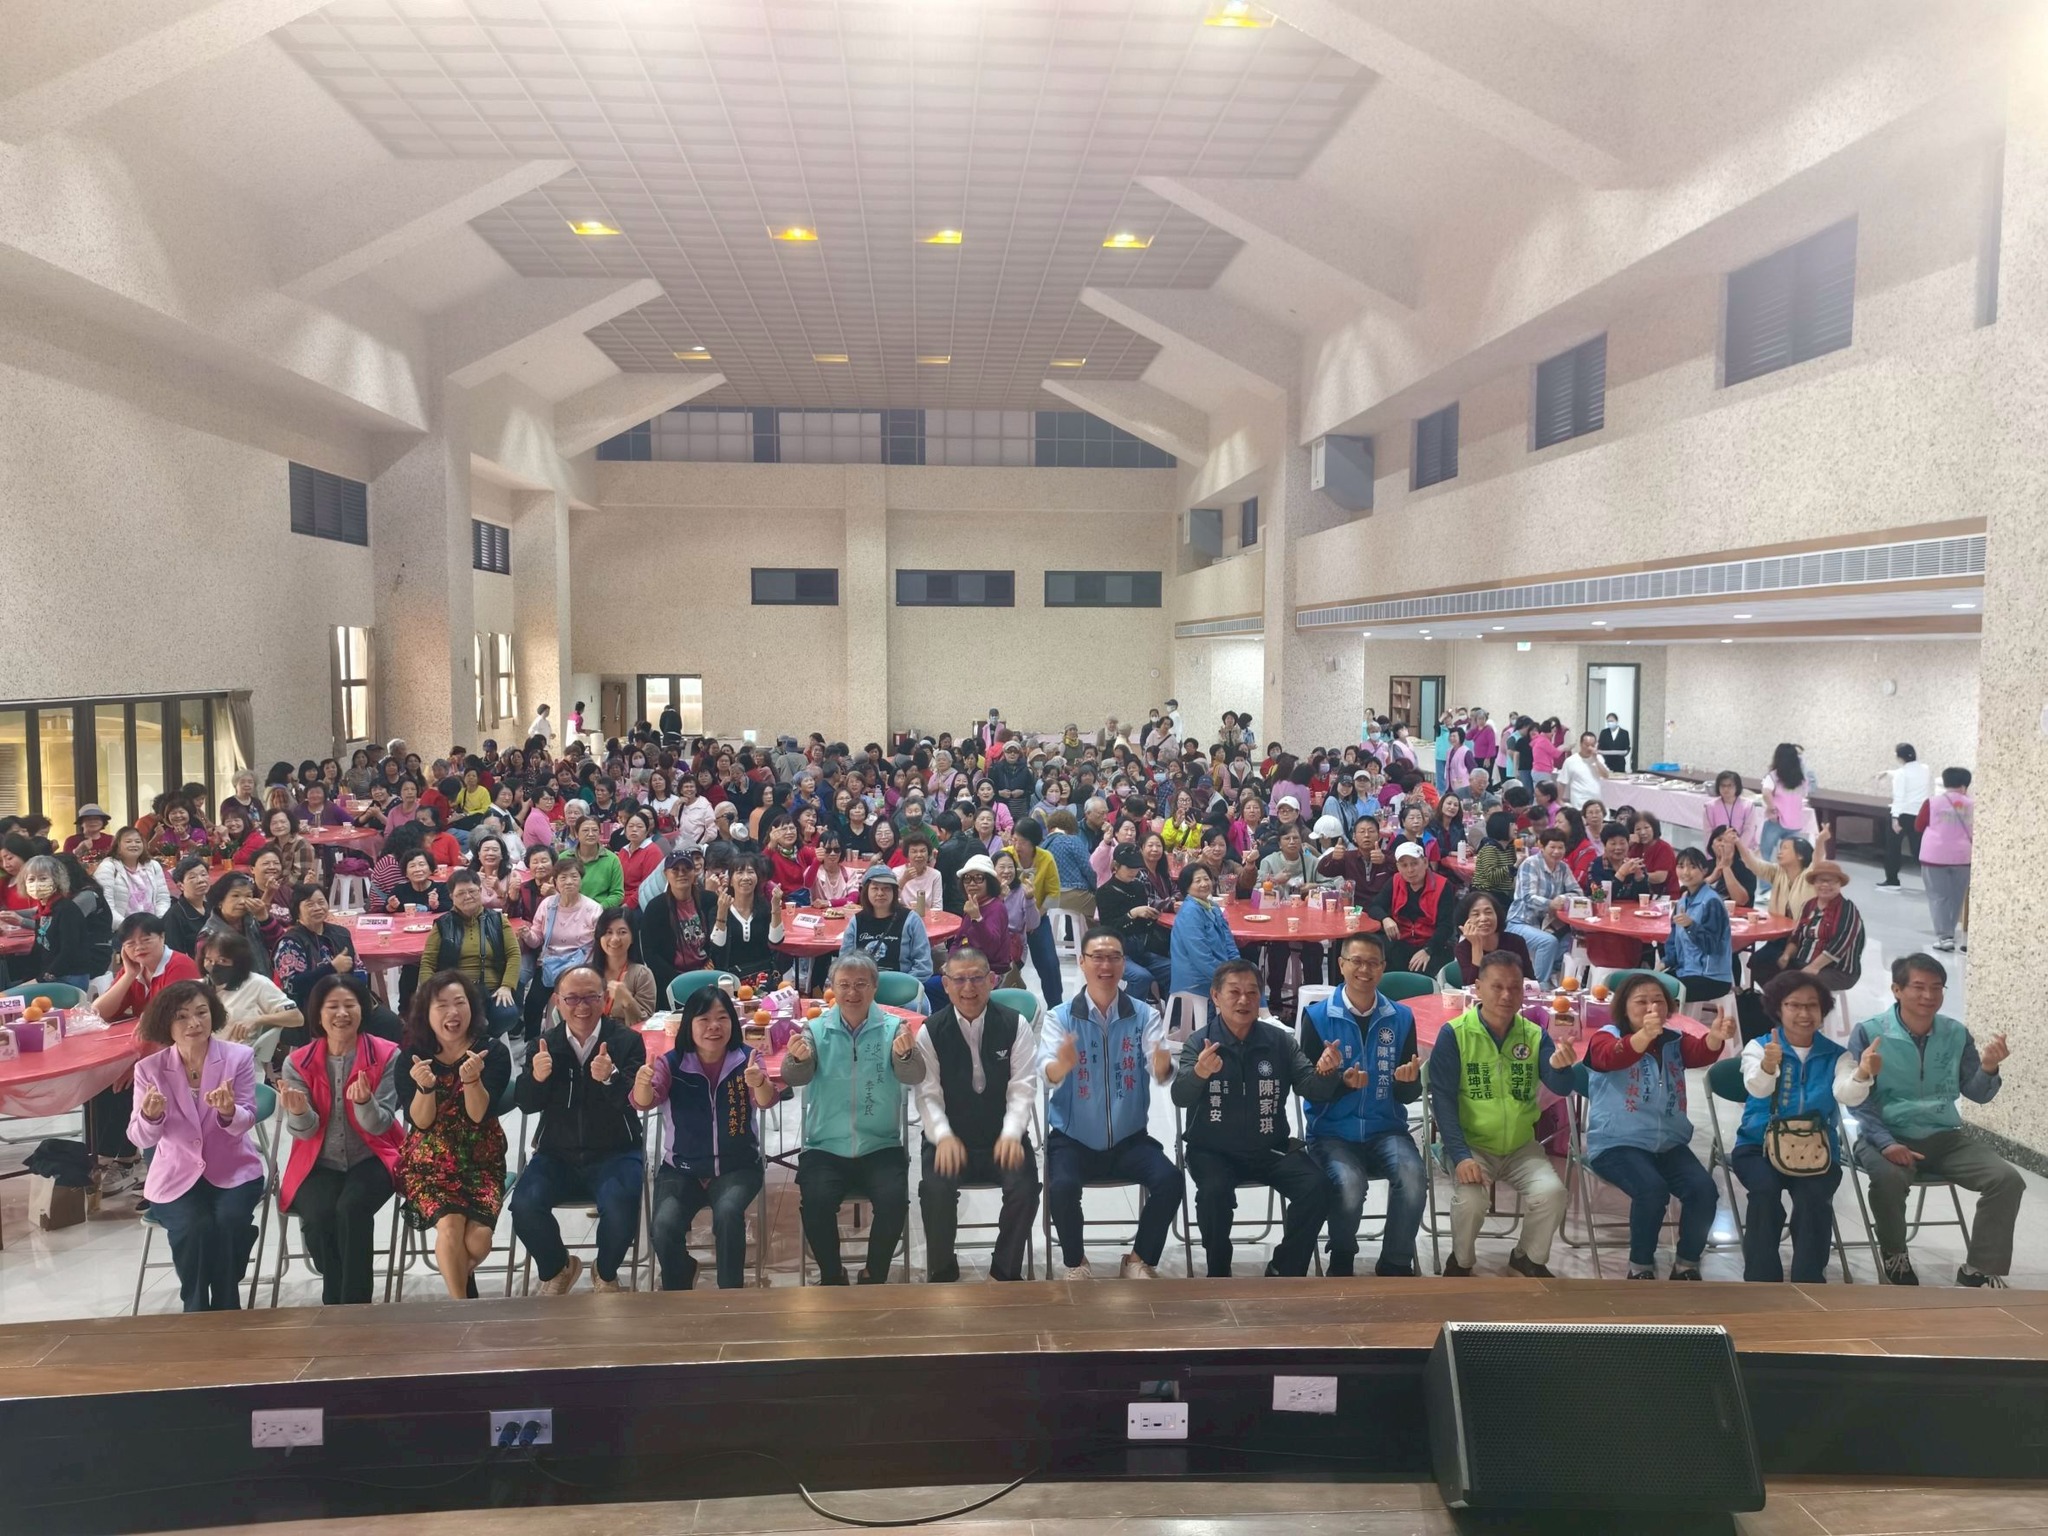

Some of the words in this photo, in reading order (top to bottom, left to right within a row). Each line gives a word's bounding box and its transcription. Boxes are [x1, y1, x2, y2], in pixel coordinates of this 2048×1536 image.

[1209, 1079, 1222, 1122] 盧春安
[1223, 1080, 1229, 1094] 主任
[1466, 1062, 1483, 1100] 羅坤元
[1258, 1079, 1274, 1134] 陳家琪
